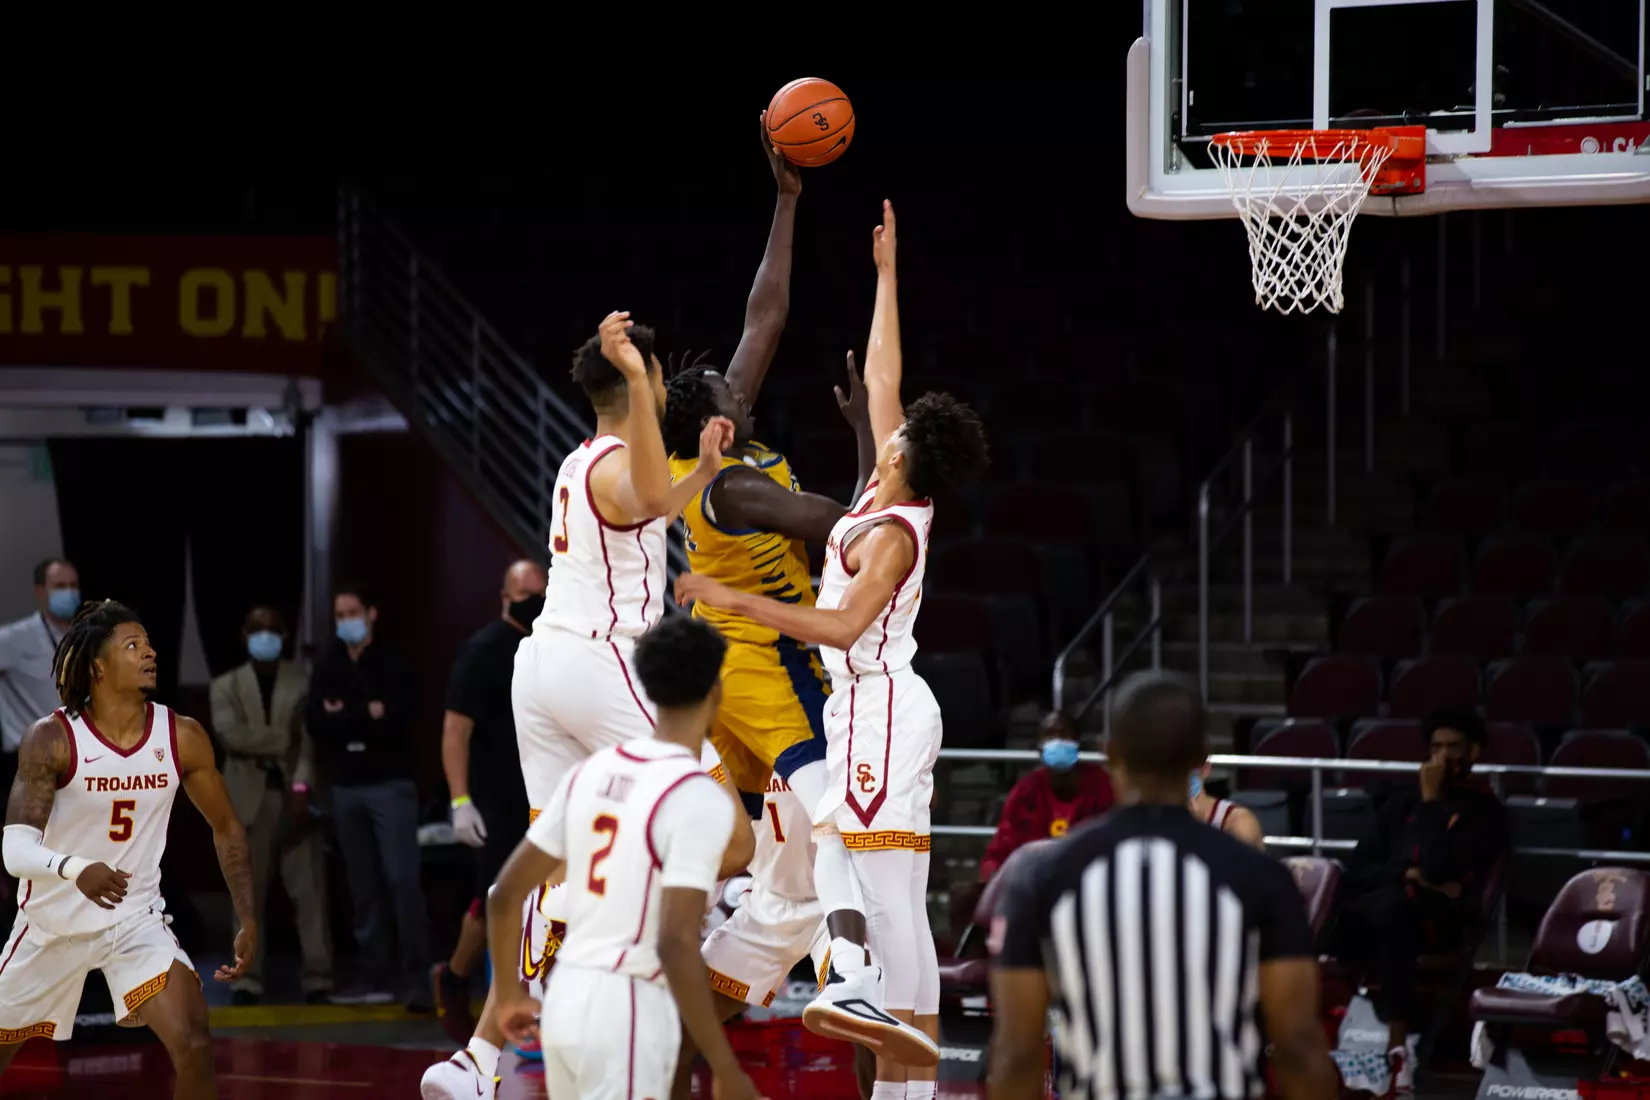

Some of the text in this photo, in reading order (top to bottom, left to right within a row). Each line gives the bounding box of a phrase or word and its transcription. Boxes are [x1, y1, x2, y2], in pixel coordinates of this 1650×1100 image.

[0, 264, 151, 336] HT
[84, 773, 169, 792] TROJANS
[109, 799, 136, 842] 5
[766, 801, 786, 844] 1
[587, 813, 620, 899] 2
